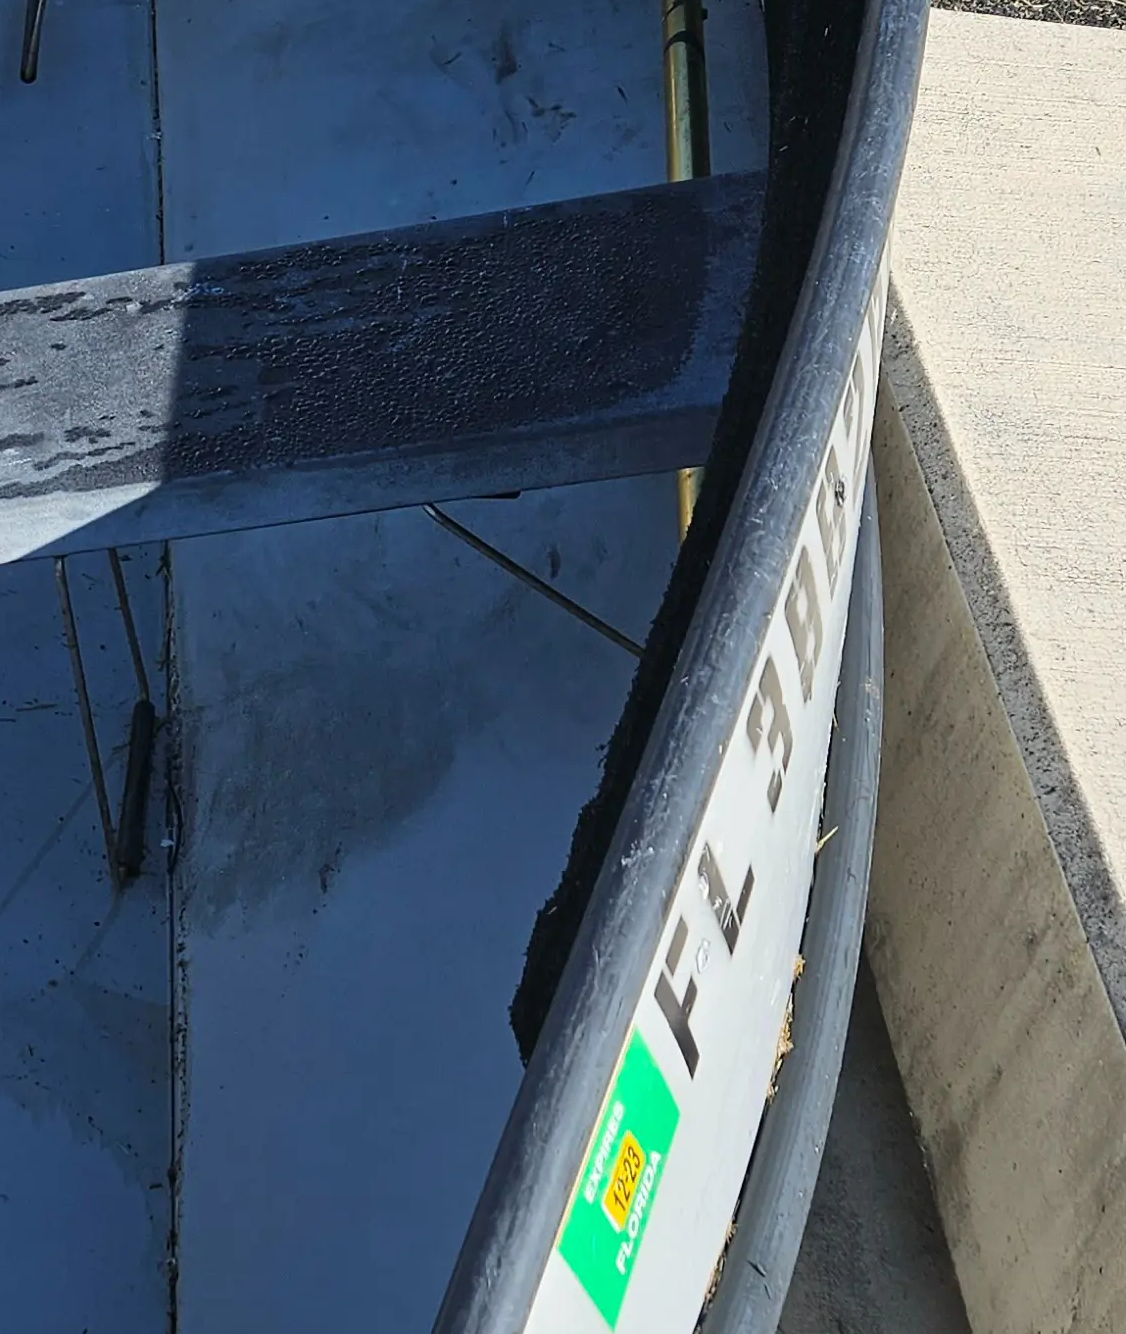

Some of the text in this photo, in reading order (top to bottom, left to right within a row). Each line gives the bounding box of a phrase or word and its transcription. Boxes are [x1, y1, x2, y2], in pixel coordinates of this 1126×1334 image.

[654, 839, 755, 1080] FL
[585, 1100, 625, 1205] EXPIRES
[612, 1145, 642, 1212] 12-23
[615, 1150, 662, 1275] FLORIDA
